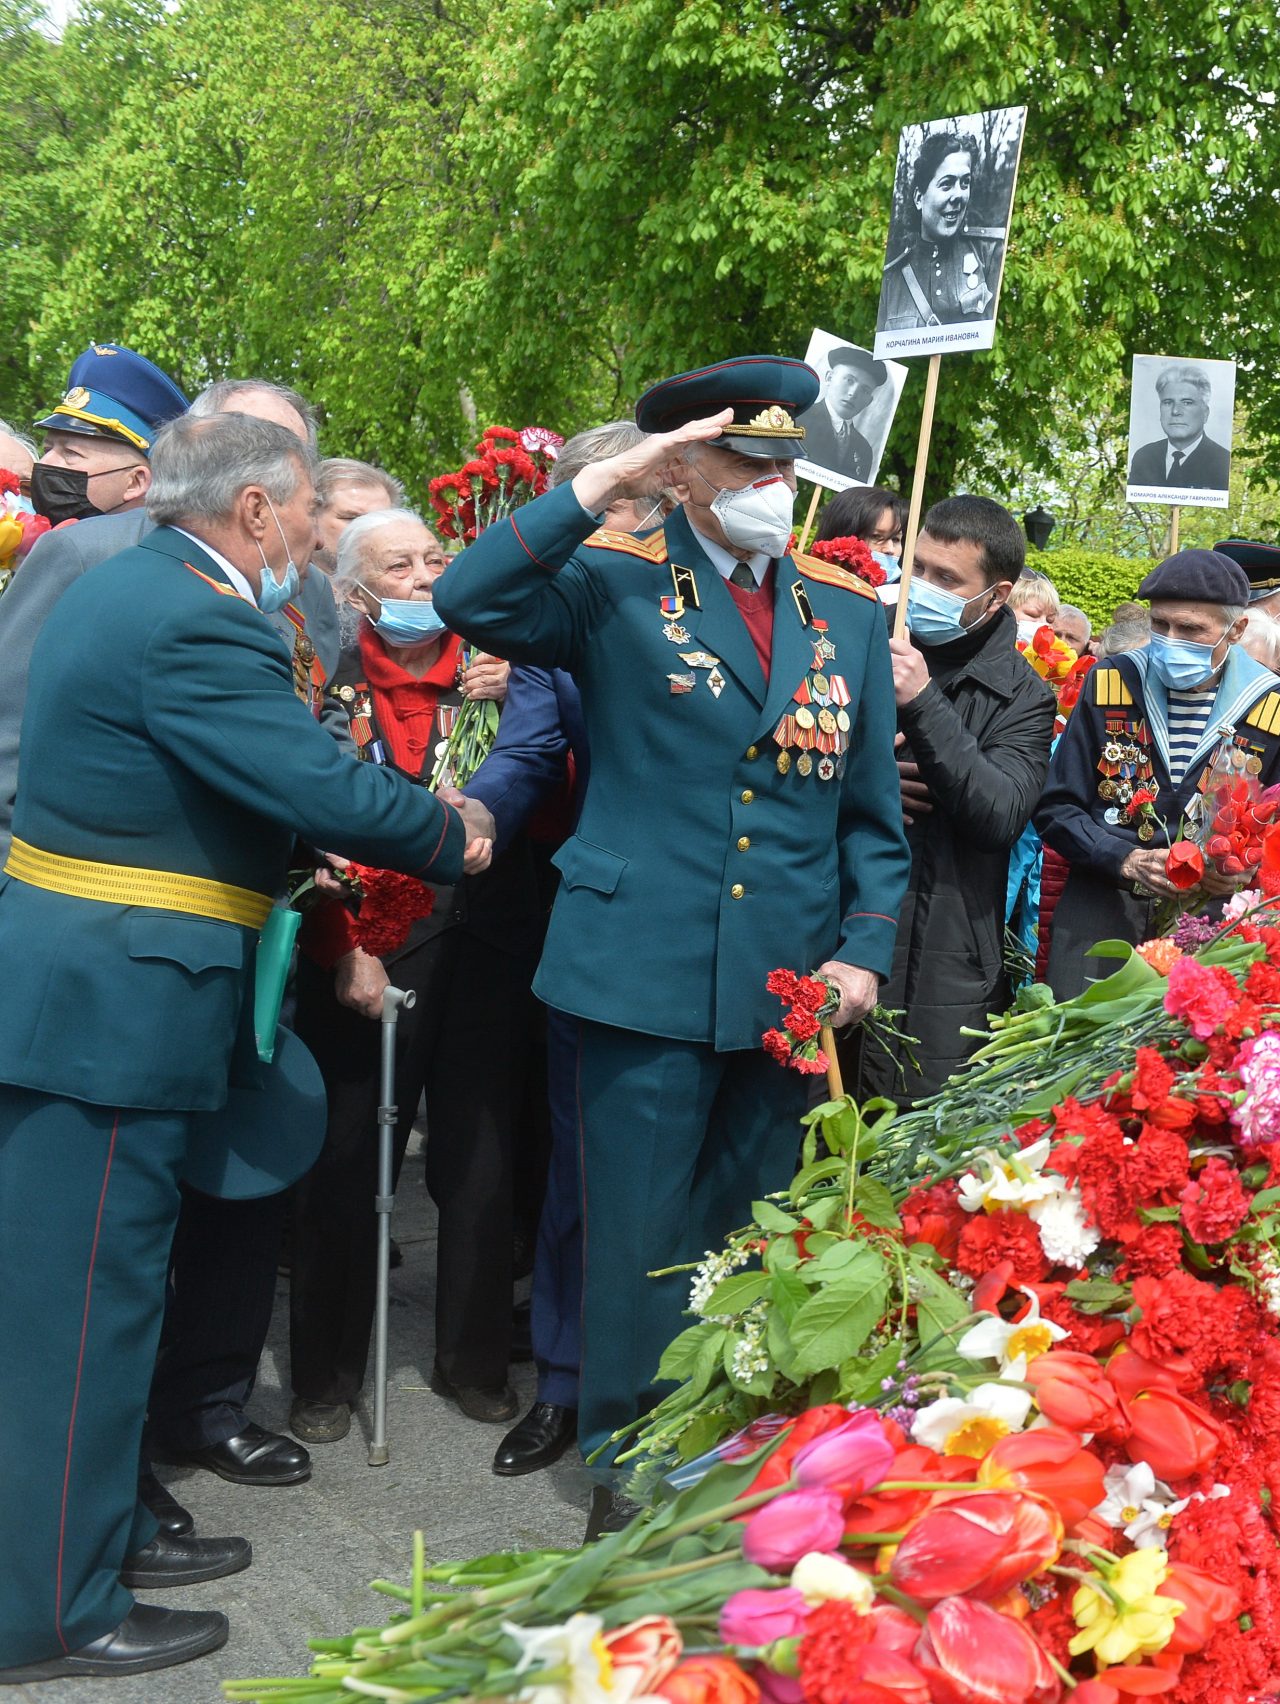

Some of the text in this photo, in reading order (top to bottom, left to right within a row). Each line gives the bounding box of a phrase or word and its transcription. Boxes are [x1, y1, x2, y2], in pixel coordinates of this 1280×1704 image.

[886, 331, 980, 349] КОРЧАГИНА МАРИЯ ИВАНОВНА
